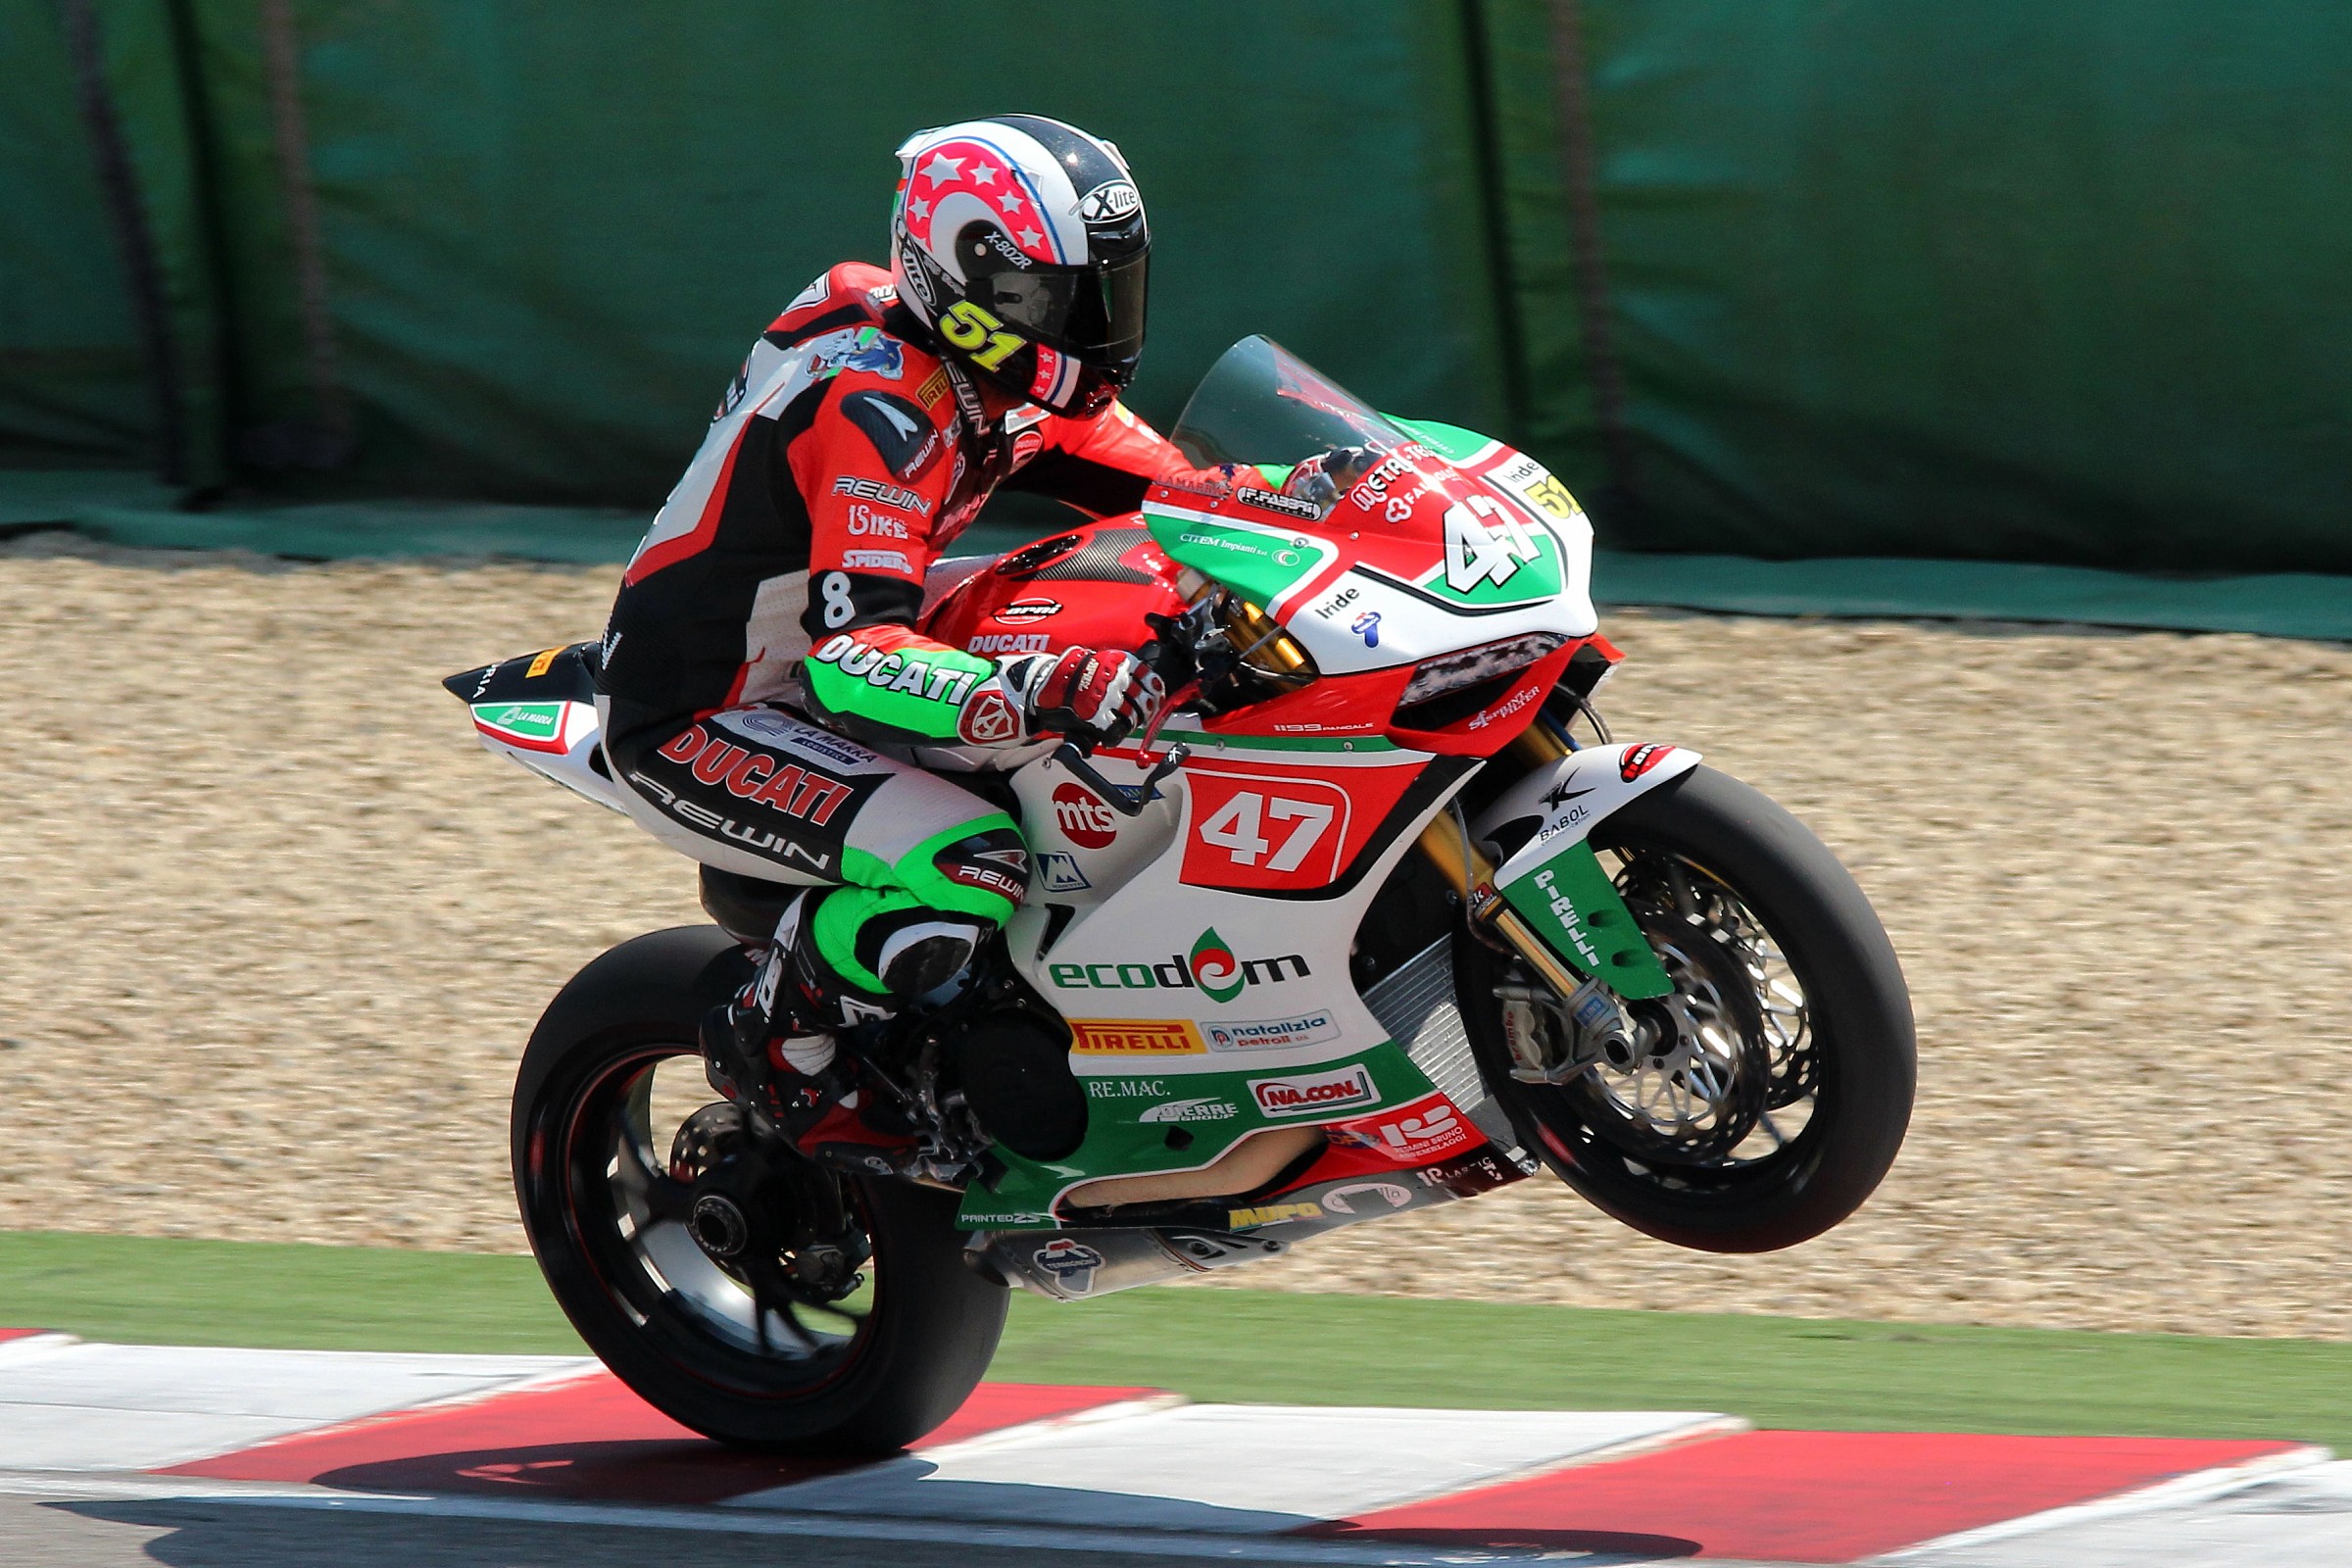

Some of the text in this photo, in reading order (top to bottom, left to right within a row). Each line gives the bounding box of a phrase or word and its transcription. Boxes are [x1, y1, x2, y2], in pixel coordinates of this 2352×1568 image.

[1092, 189, 1136, 220] X-lite
[939, 299, 1027, 373] 51
[905, 428, 939, 478] REWIN
[832, 475, 932, 516] REWIN
[1247, 488, 1313, 514] F.FABBRI
[1523, 474, 1584, 519] 51
[1180, 533, 1218, 547] CITEM
[1221, 540, 1257, 555] Impianti
[1443, 494, 1543, 595] 47
[822, 571, 857, 628] 8
[1315, 587, 1359, 620] Iride
[967, 634, 1051, 653] DUCATI
[815, 634, 980, 706] DUCATI
[658, 724, 853, 827] DUCATI
[628, 771, 831, 871] REWIN
[1054, 797, 1117, 832] mts
[1200, 791, 1334, 872] 47
[1540, 805, 1589, 842] BABOL
[957, 864, 1027, 906] REWIN
[1534, 870, 1600, 967] PIRELLI
[1049, 936, 1311, 1002] ecodom
[1070, 1022, 1192, 1050] PIRELLI
[1089, 1081, 1171, 1099] RE.MAC.
[1267, 1080, 1362, 1105] NA.CON.
[1430, 1126, 1463, 1145] BRUNO
